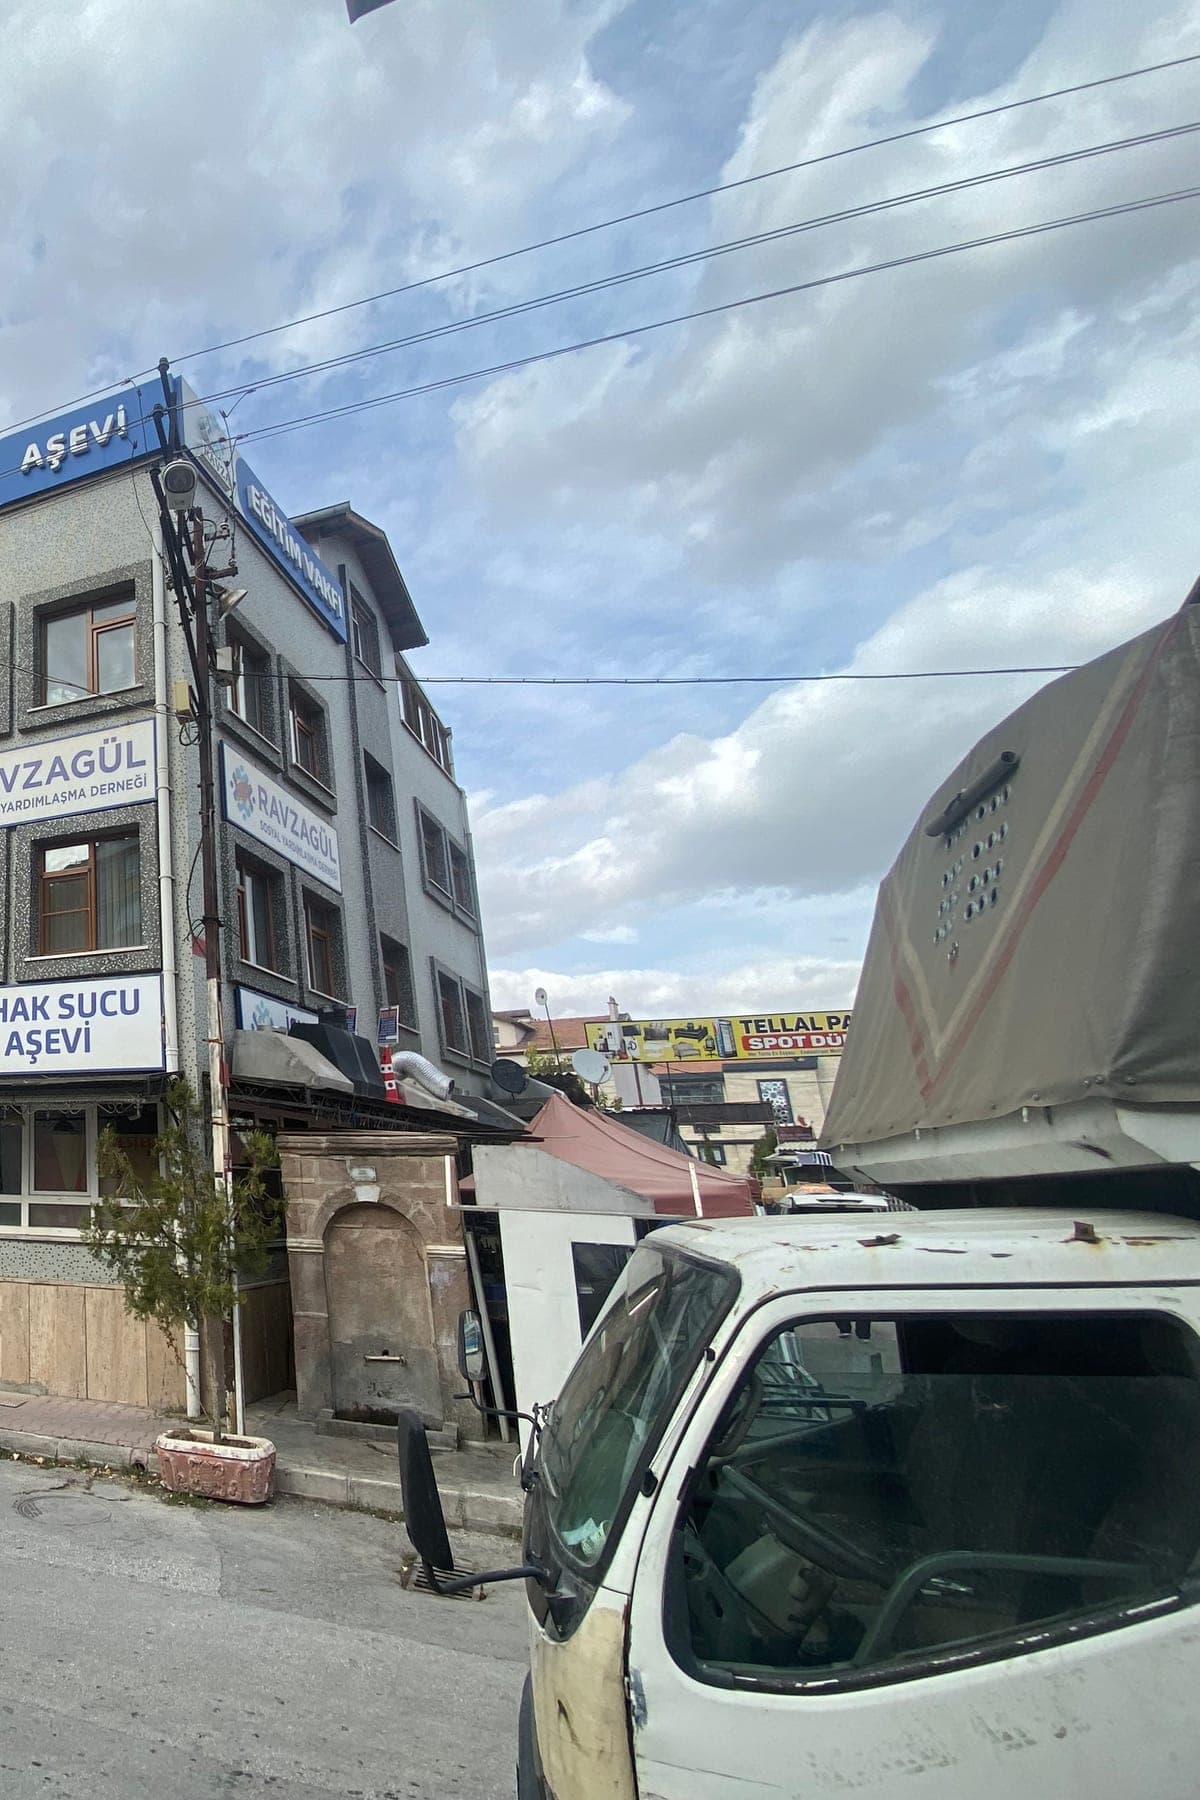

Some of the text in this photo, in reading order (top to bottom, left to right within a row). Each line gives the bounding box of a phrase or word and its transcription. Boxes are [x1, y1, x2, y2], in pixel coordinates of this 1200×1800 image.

[20, 404, 128, 472] AŞEVİ
[247, 485, 343, 619] EĞİTİM VAKFI
[0, 788, 87, 814] YARDIMLAŞMA
[90, 773, 147, 797] DERNEĞİ
[257, 784, 337, 864] RAVZAGÜL
[58, 989, 140, 1019] SUCU
[739, 1016, 823, 1034] TELLAL
[4, 1020, 91, 1064] AŞEVİ
[748, 1035, 807, 1049] SPOT
